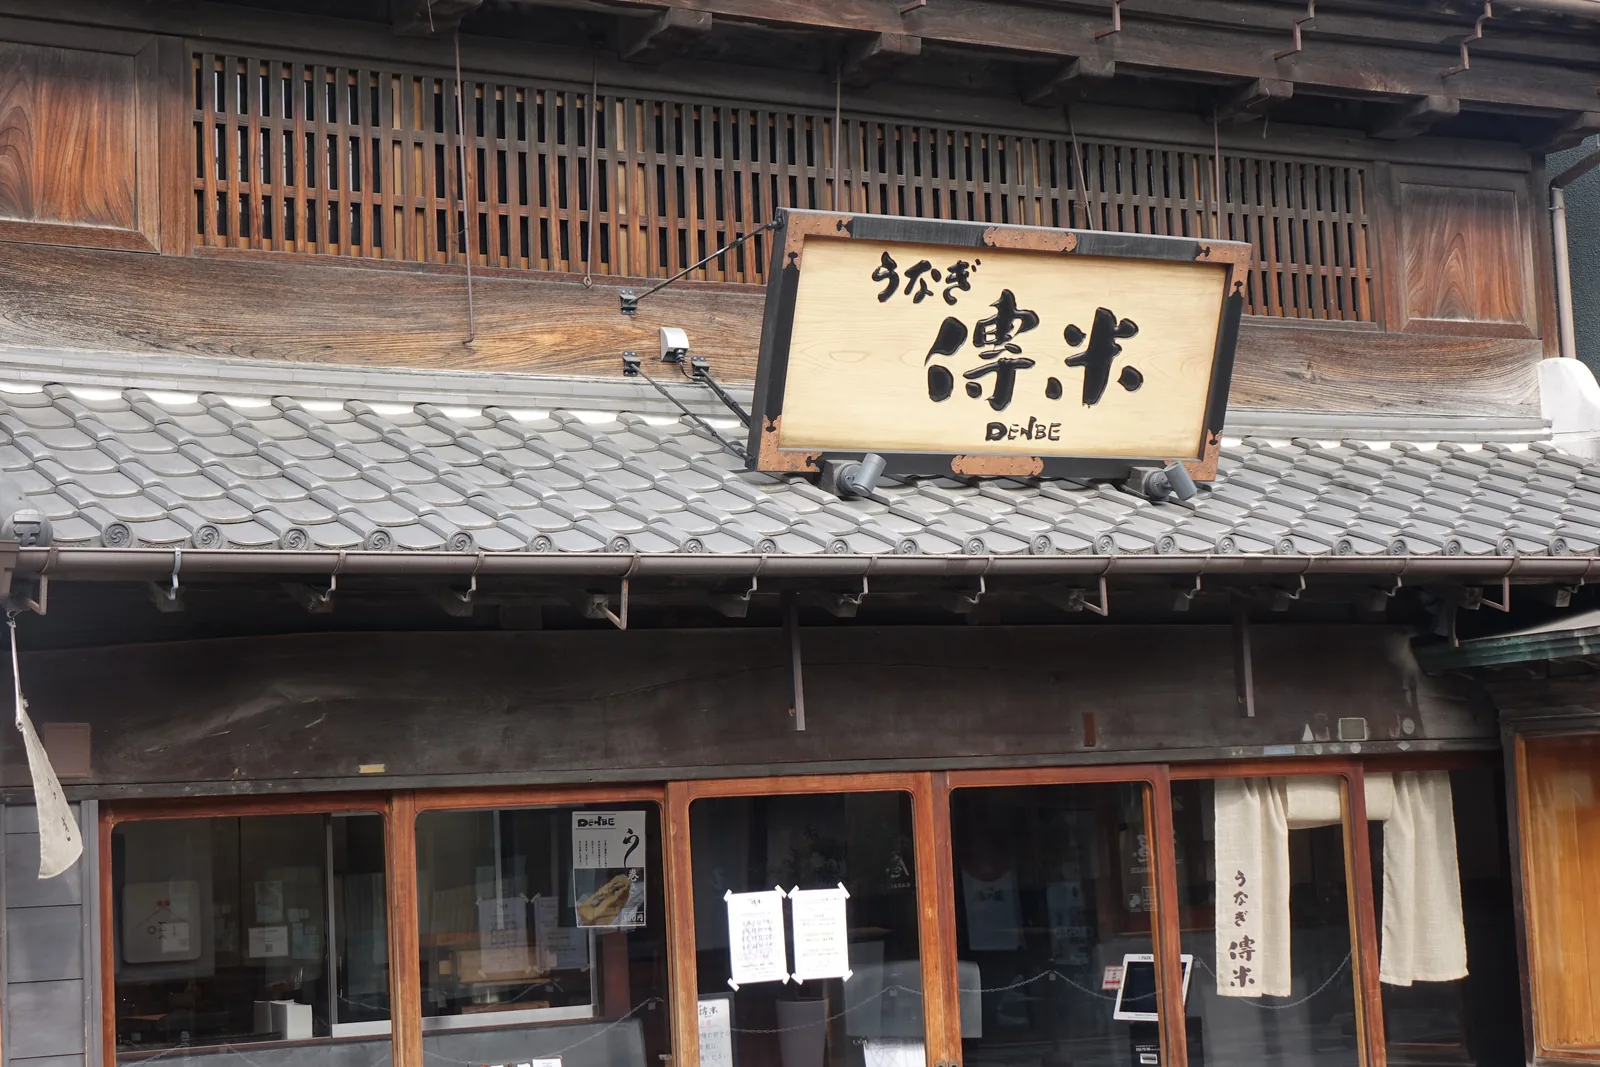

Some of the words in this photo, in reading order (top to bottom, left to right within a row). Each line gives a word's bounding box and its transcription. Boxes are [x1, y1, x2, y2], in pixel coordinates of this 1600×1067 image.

[871, 250, 982, 305] うなぎ
[1233, 870, 1249, 927] うなぎ
